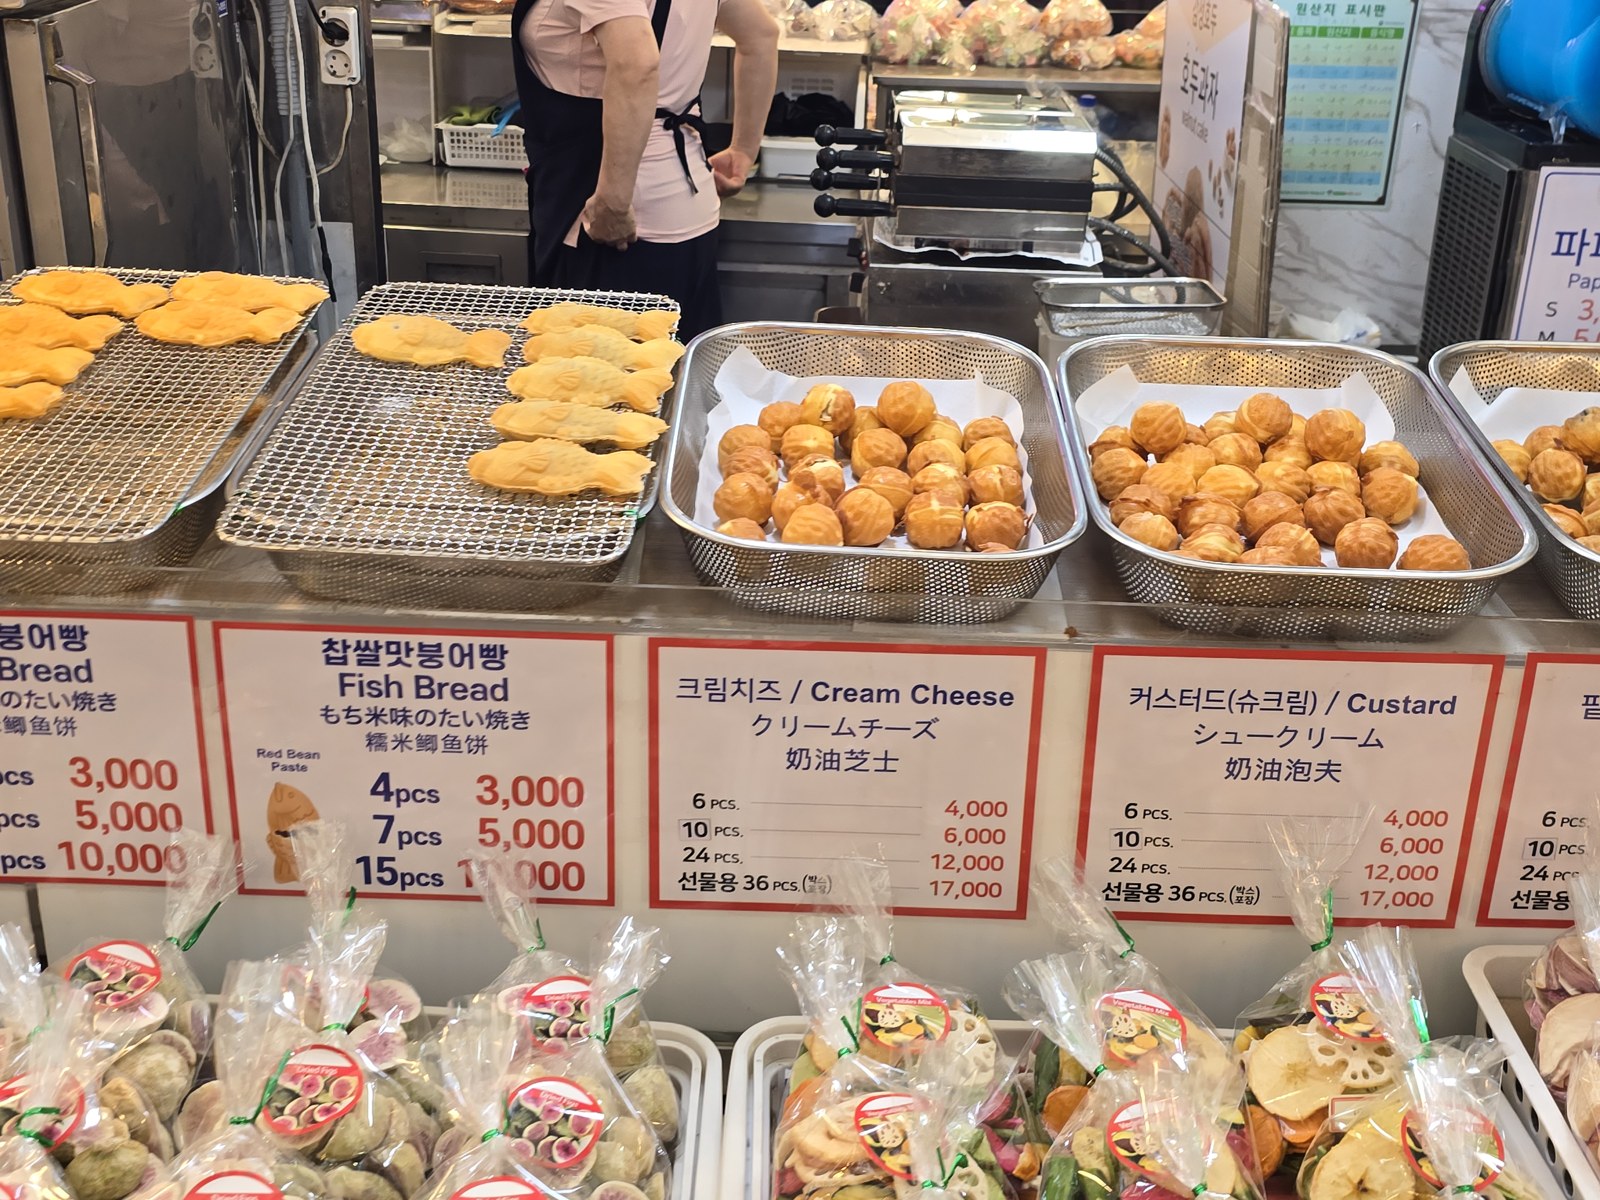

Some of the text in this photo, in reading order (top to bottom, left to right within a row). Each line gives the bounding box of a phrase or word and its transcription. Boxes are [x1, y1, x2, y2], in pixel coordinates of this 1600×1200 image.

[1296, 3, 1385, 17] 원산지 표시판
[1180, 52, 1219, 120] 호두과자
[1545, 301, 1557, 317] S
[0, 623, 89, 652] 붕어빵
[321, 637, 509, 671] 찹쌀맛붕어빵
[0, 656, 94, 684] Bread
[0, 690, 117, 712] のたい焼き
[338, 673, 509, 702] Fish Bread
[676, 677, 1015, 707] 크림치즈 / Cream Cheese
[1129, 686, 1457, 715] 커스터드(슈크림) / Custard
[0, 715, 77, 737] 鲫鱼饼
[320, 705, 531, 731] もち米味のたい焼き
[752, 713, 940, 741] クリームチーズ
[365, 733, 489, 756] 糯米鲫鱼饼
[1195, 723, 1384, 749] シュークリーム
[256, 748, 320, 760] Red Bean
[271, 762, 308, 772] Paste
[785, 747, 900, 774] 奶油芝士
[68, 756, 179, 793] 3,000
[1224, 757, 1342, 783] 奶油泡夫
[370, 771, 585, 811] 4pcs 3,000
[75, 799, 183, 835] 5,000
[692, 793, 706, 810] 6
[944, 800, 1008, 820] 4,000
[1124, 803, 1448, 829] 6 PCS. 4,000
[1542, 811, 1556, 827] 6
[372, 815, 585, 852] 7pcs 5,000
[682, 821, 708, 838] 10
[944, 827, 1006, 847] 6,000
[1113, 831, 1444, 856] 10 PCS. 6,000
[1, 841, 188, 876] pcs 10,000
[682, 847, 710, 864] 24
[931, 853, 1004, 874] 12,000
[1528, 841, 1554, 857] 10
[355, 856, 445, 891] 15pcs
[1108, 856, 1439, 882] 24 PCS. 12,000
[1520, 865, 1549, 881] 24
[678, 872, 738, 892] 선물용
[743, 875, 769, 891] 36
[929, 880, 1002, 899] 17,000
[1101, 882, 1164, 903] 선물용
[1168, 885, 1196, 902] 36
[1198, 891, 1227, 903] PCS.
[1360, 890, 1434, 909] 17,000
[1510, 890, 1570, 910] 선물용
